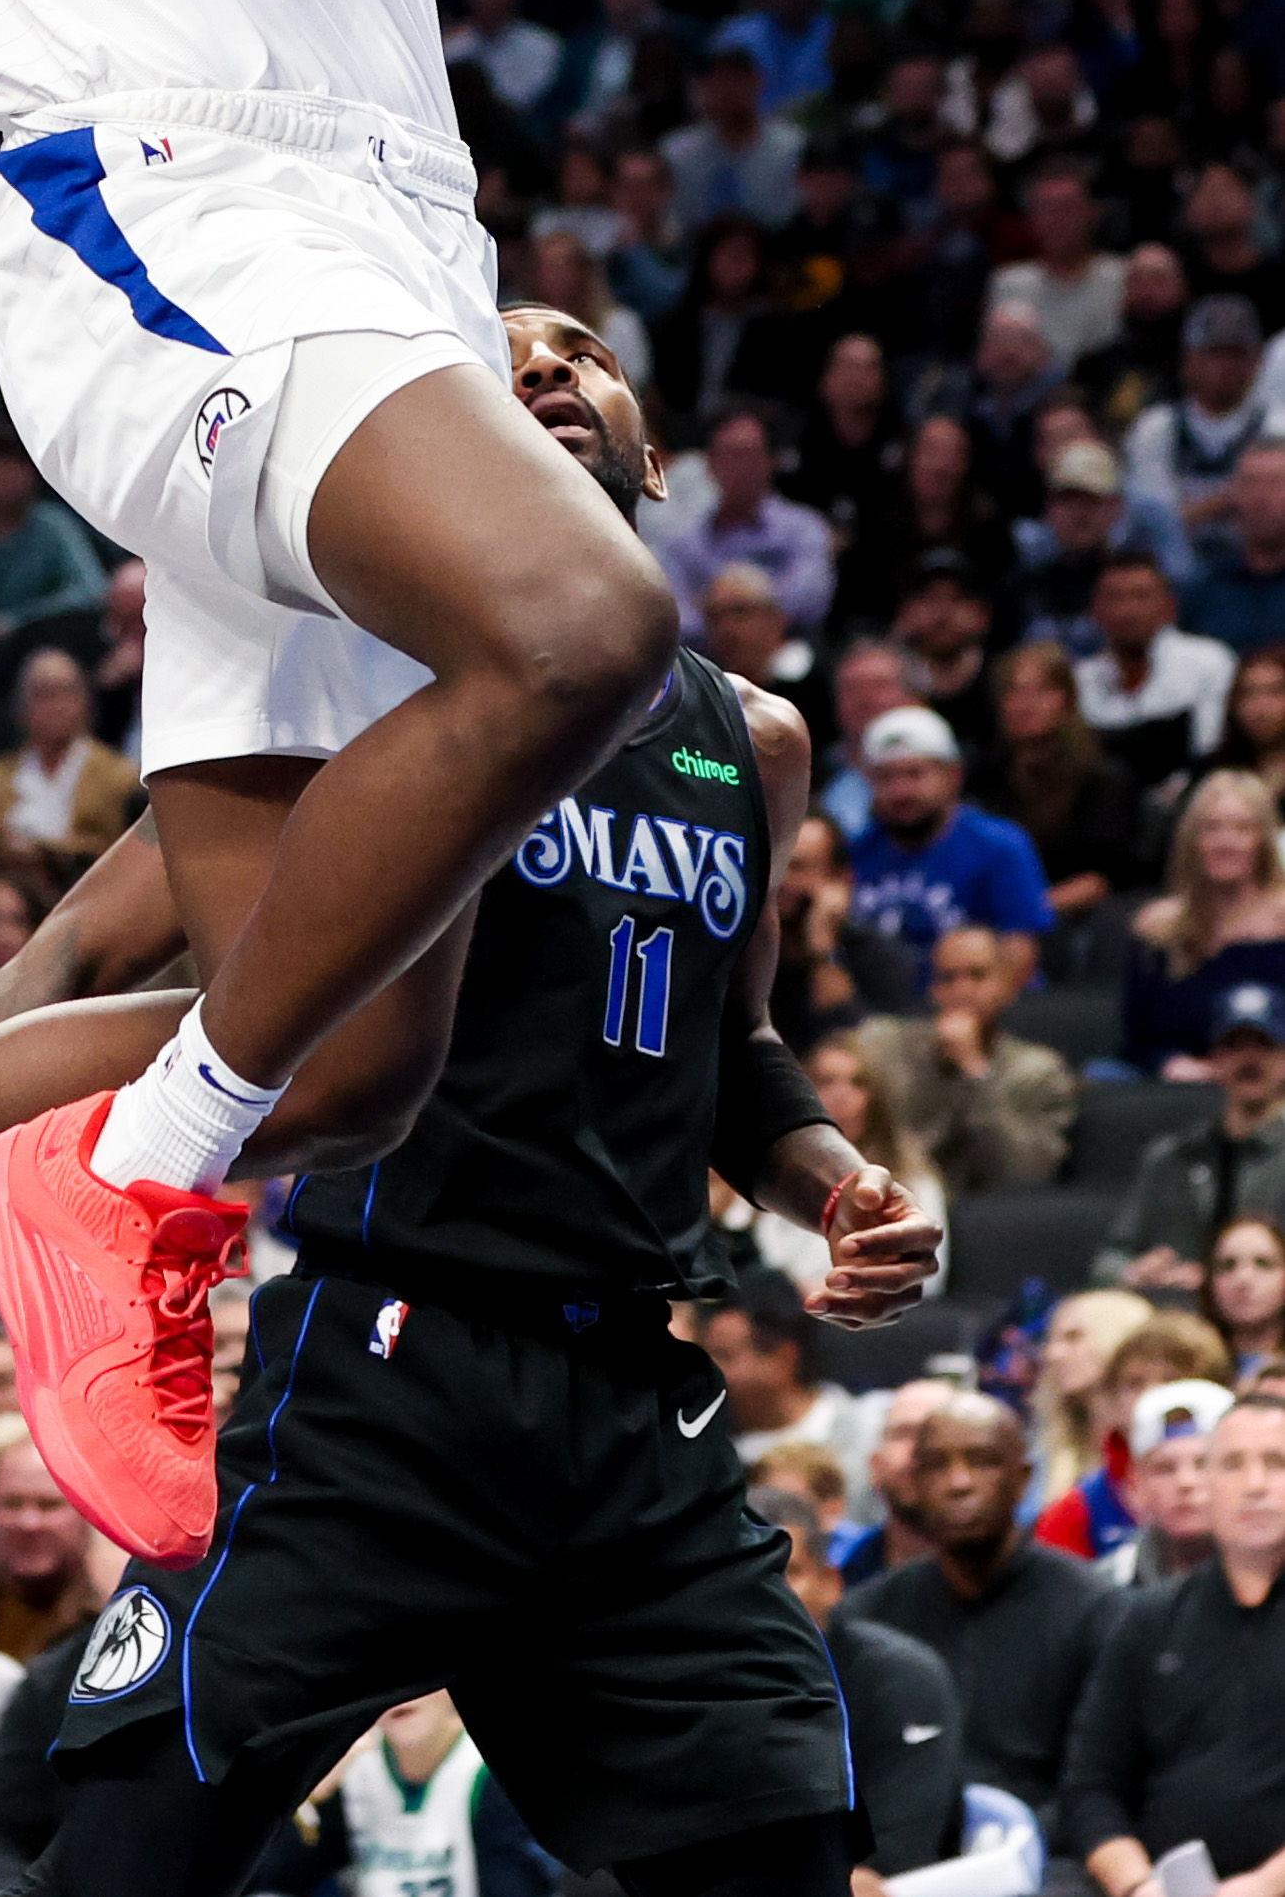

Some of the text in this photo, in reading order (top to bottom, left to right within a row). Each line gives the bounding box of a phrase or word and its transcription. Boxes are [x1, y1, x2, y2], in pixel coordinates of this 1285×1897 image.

[671, 746, 740, 786] chime
[516, 794, 747, 940] MAVS
[603, 914, 675, 1058] 11
